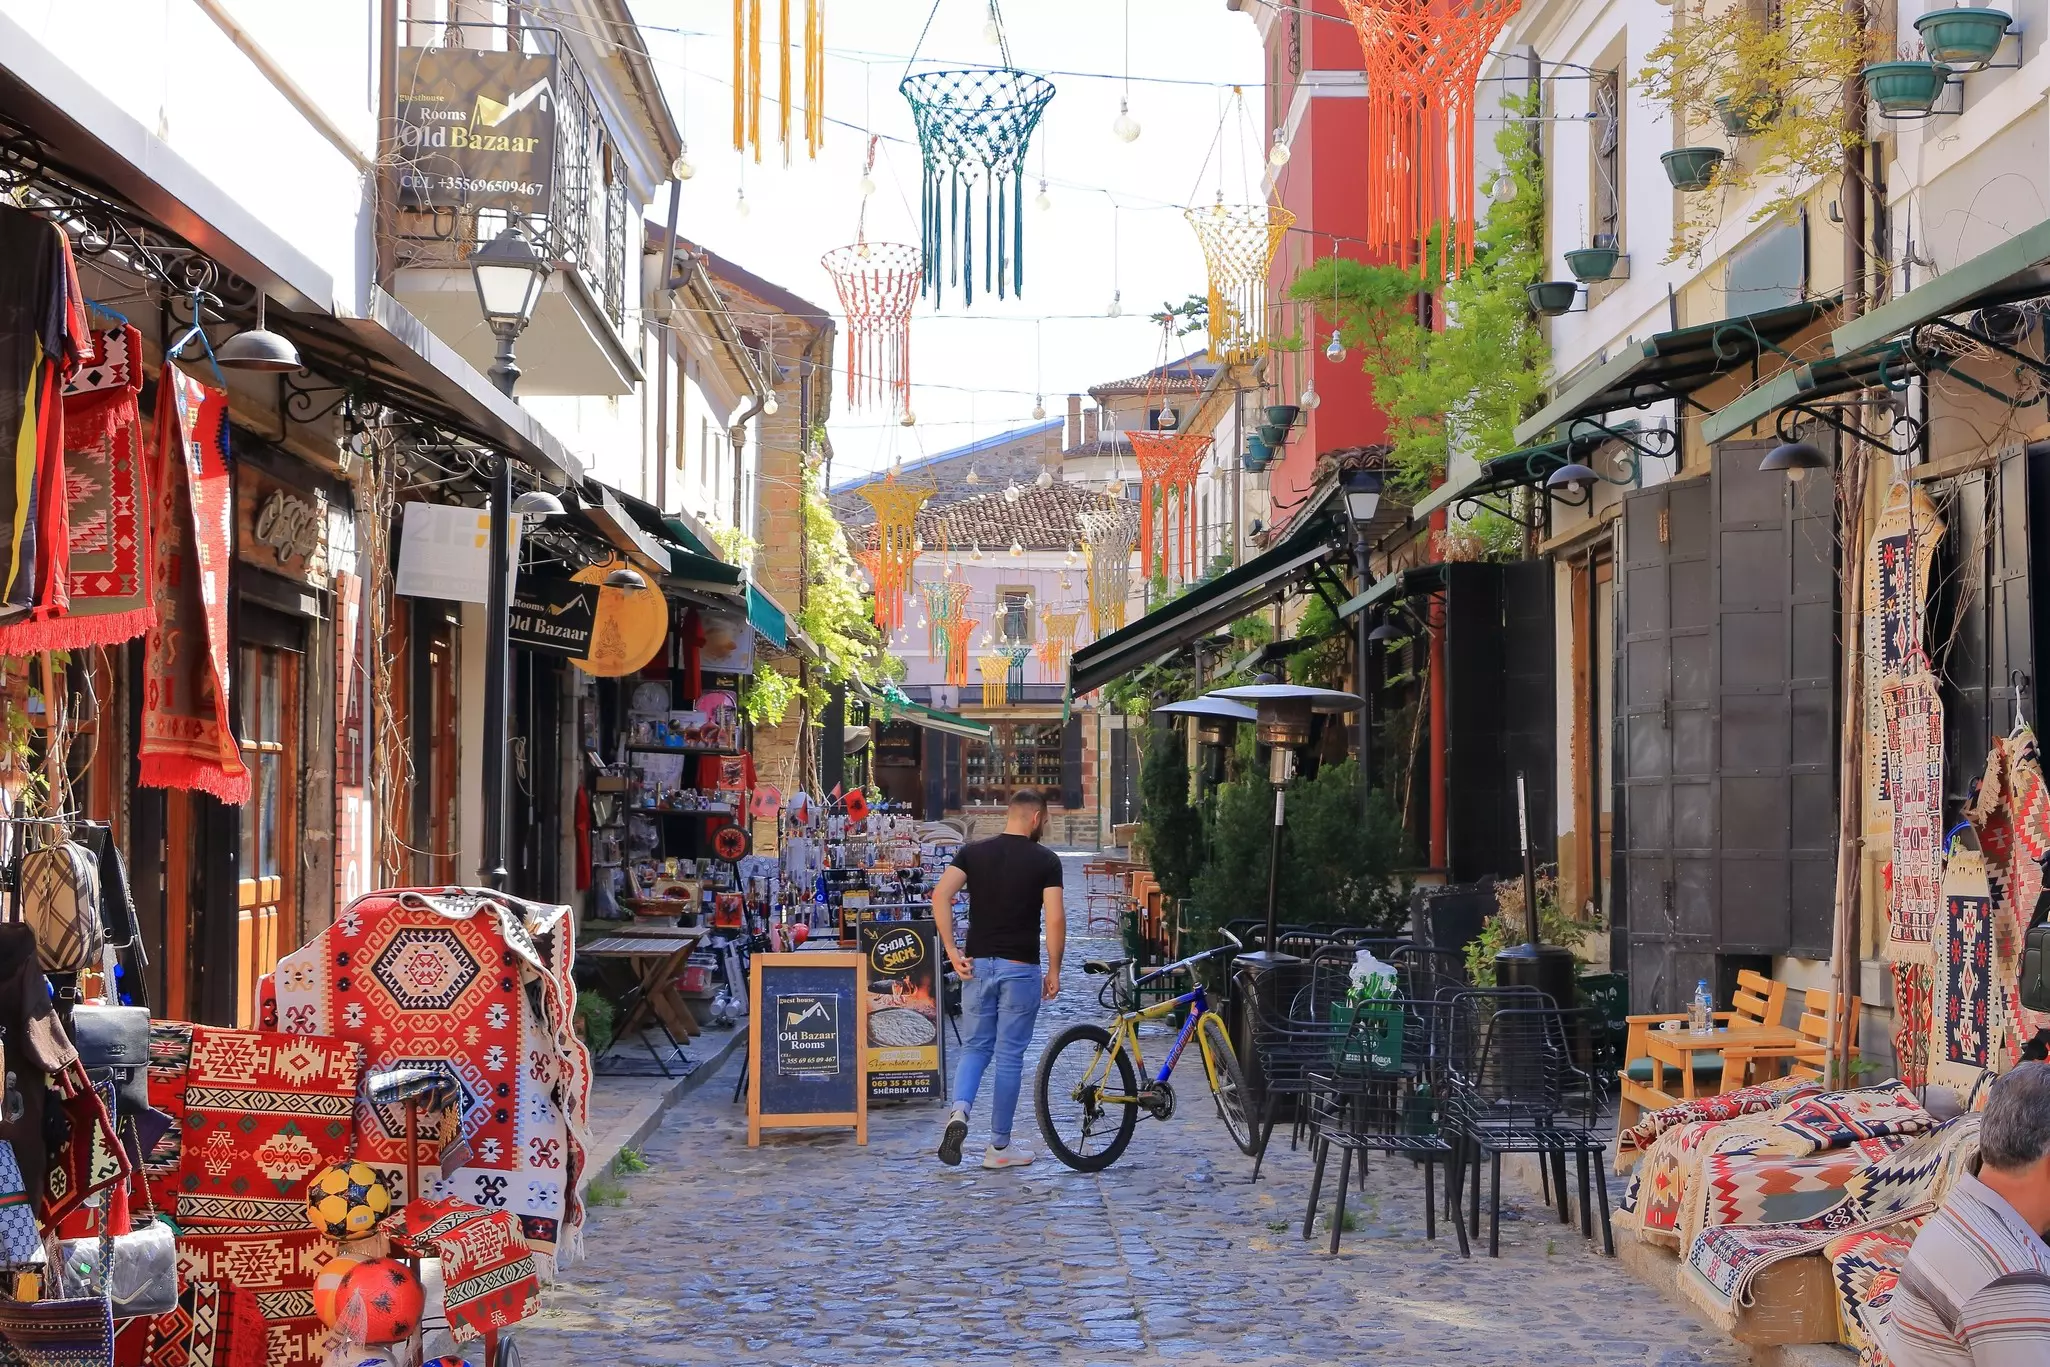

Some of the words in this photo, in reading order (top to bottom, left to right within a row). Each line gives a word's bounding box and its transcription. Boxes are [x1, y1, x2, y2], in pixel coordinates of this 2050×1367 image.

[400, 93, 445, 102] guesthouse
[420, 107, 467, 120] Rooms
[401, 126, 446, 147] Old
[450, 126, 539, 153] Bazaar
[400, 175, 434, 189] CEL
[438, 176, 543, 196] +355696509467
[513, 598, 545, 612] Rooms
[534, 618, 588, 641] Bazaar
[779, 1031, 798, 1041] Old
[801, 1031, 836, 1040] Bazaar
[791, 1041, 825, 1050] Rooms
[873, 1087, 909, 1095] SHËRBIM
